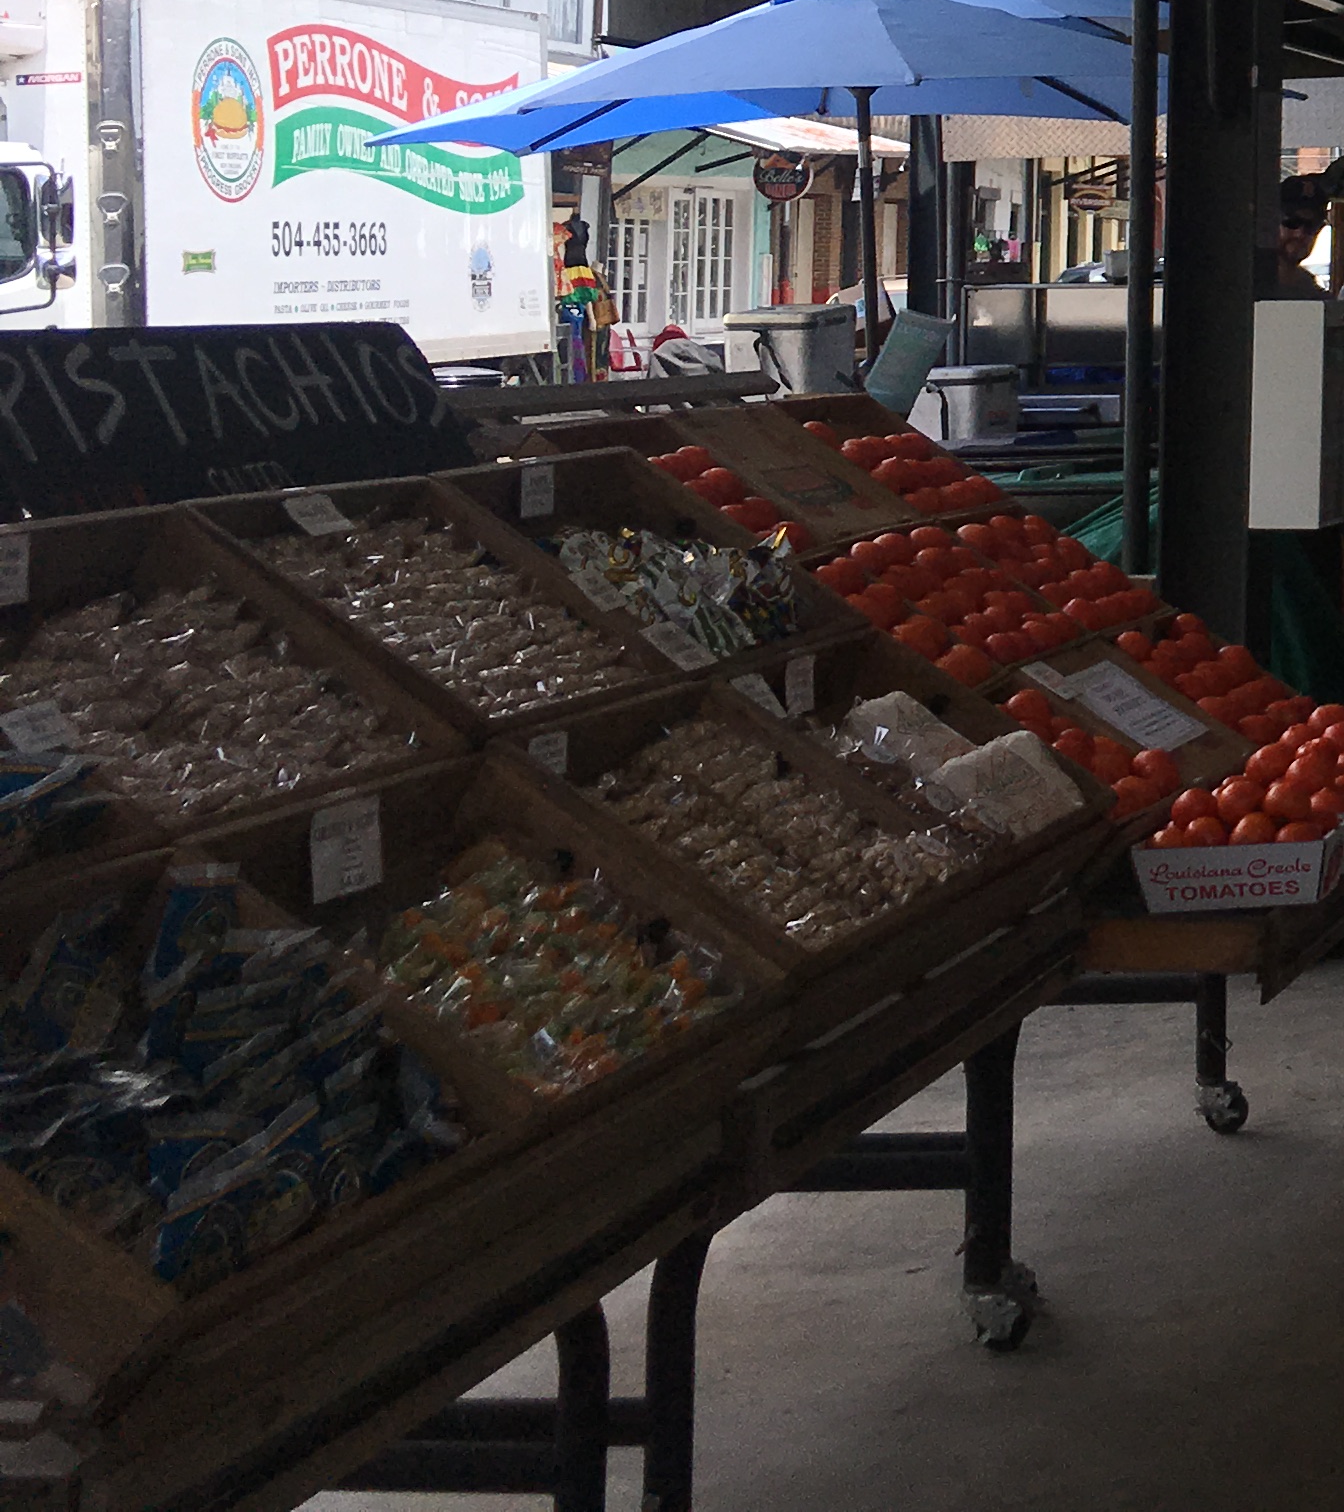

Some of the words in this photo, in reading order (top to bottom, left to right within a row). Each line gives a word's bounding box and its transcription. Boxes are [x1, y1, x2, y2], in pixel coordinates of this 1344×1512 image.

[28, 73, 79, 84] MORGAN
[274, 33, 408, 113] PERRONE
[422, 76, 441, 121] &
[291, 122, 333, 164] FAMILY
[337, 123, 376, 163] OWNED
[379, 144, 400, 173] AND
[405, 149, 455, 198] OPERATED
[458, 171, 486, 203] SINCE
[488, 168, 511, 201] 1924
[271, 221, 388, 257] 504-455-3663
[273, 281, 319, 294] IMPORTERS
[326, 279, 381, 293] DISTRIBUTORS
[1150, 863, 1242, 885] Louisiana
[1247, 859, 1313, 879] Creole
[1165, 880, 1300, 902] TOMATOES
